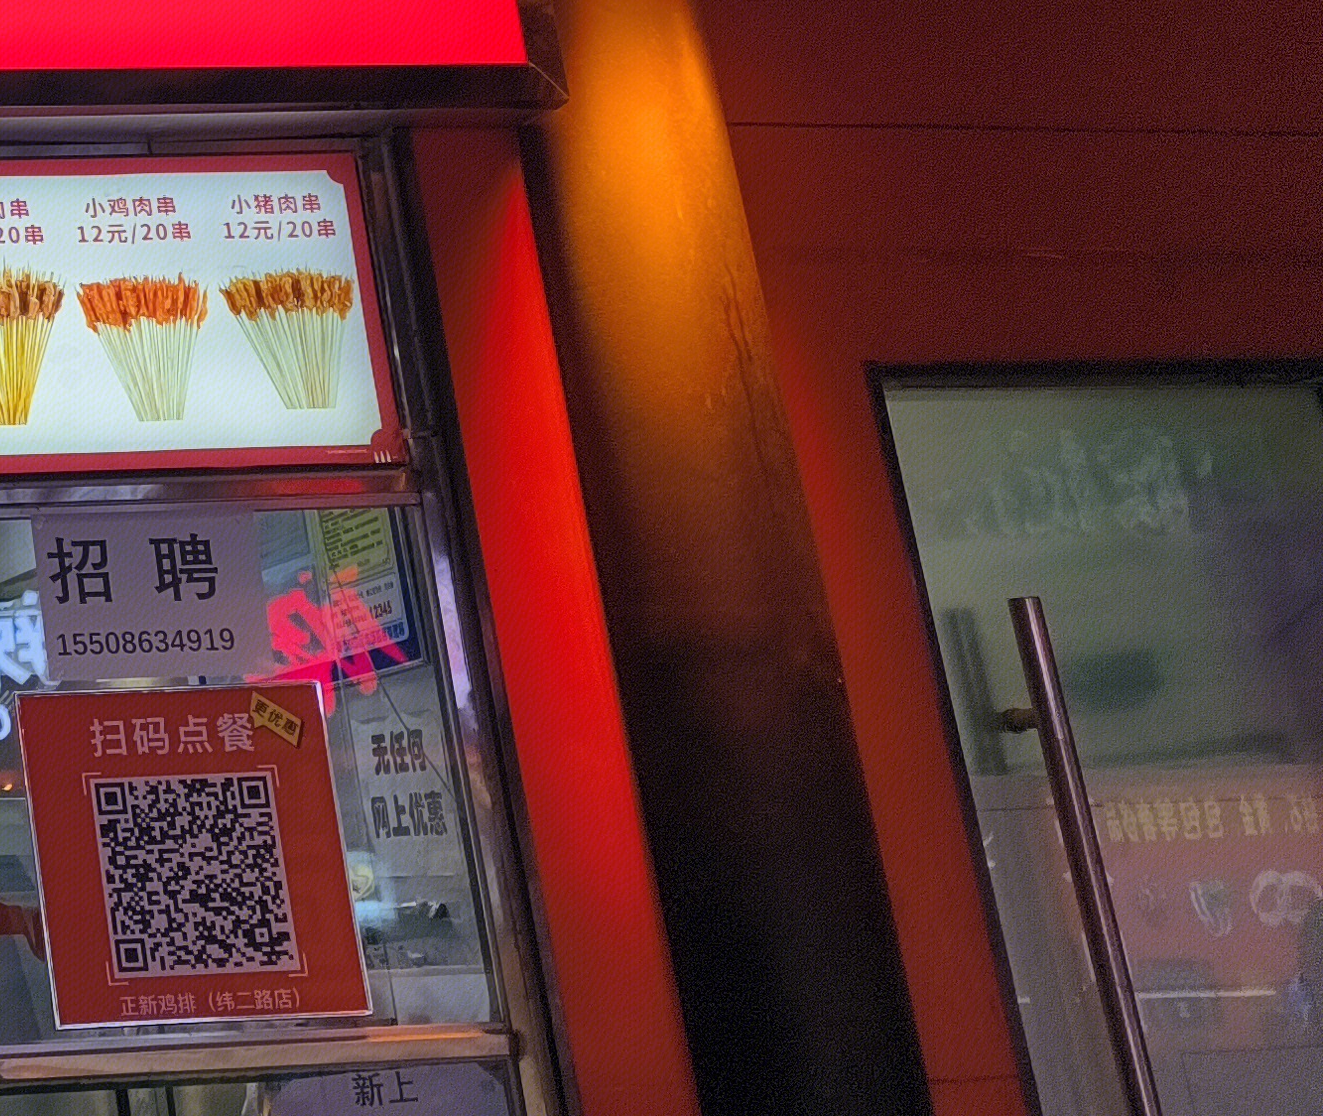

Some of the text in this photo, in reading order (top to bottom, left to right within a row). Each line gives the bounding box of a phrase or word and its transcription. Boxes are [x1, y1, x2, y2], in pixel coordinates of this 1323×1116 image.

[83, 195, 178, 219] 小鸡肉串
[229, 192, 322, 216] 小猪肉串
[76, 220, 193, 246] 12元/20串
[222, 218, 337, 243] 12元/20串
[47, 532, 219, 605] 招聘
[56, 627, 236, 657] 15508634919
[252, 698, 300, 737] 更优惠
[89, 712, 255, 759] 扫码点餐
[370, 728, 427, 776] 无任何
[370, 790, 448, 838] 网上优惠
